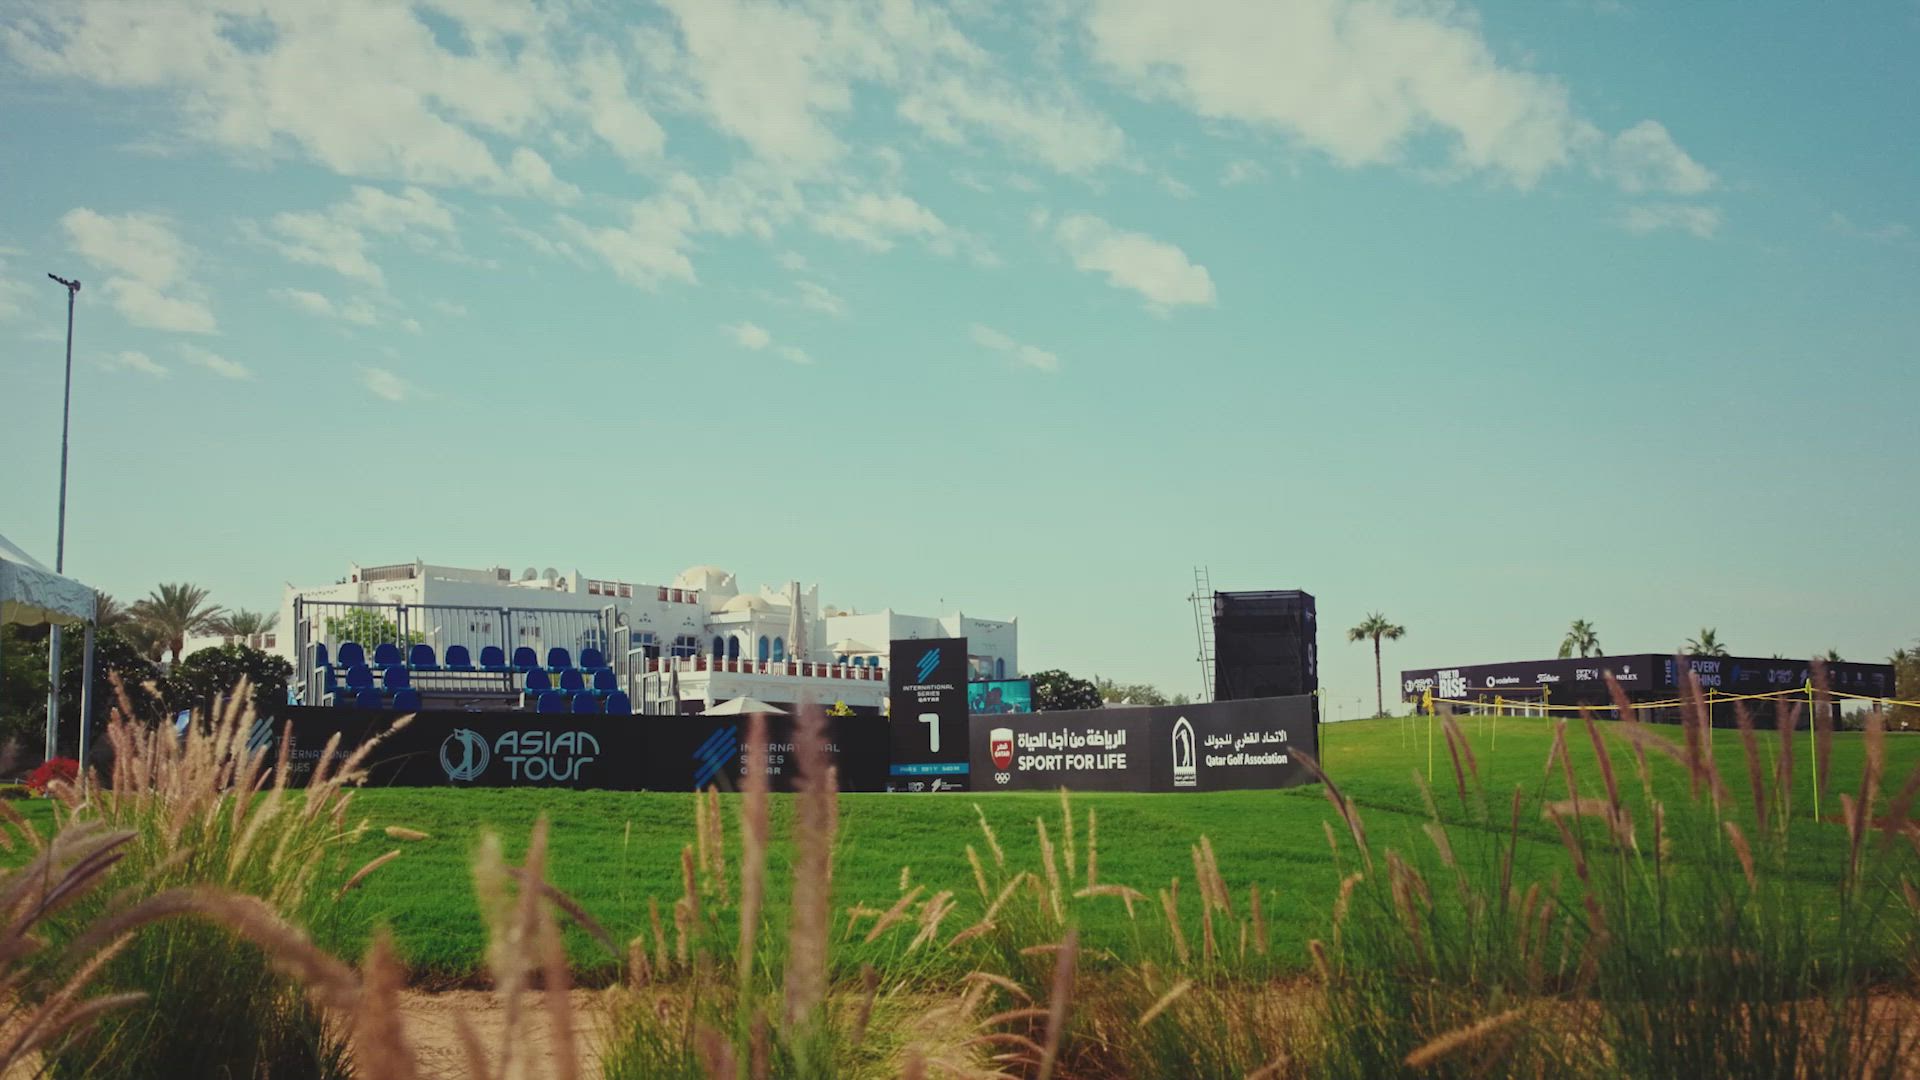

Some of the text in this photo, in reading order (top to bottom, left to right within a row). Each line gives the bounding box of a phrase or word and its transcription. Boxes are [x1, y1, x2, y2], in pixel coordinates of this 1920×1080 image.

[1691, 660, 1720, 673] EVERY
[1616, 673, 1638, 681] ROLEX
[1439, 677, 1467, 698] RISE
[275, 736, 297, 746] TE
[918, 713, 940, 753] 1
[1018, 732, 1047, 751] الحياة
[1069, 731, 1085, 749] من
[1087, 729, 1126, 750] الرياضة
[494, 730, 600, 755] ASIAN
[740, 743, 840, 752] INRNANAL
[274, 763, 310, 772] SIES
[740, 755, 784, 764] SES
[1018, 753, 1127, 771] SPORT FOR LIFE
[1206, 751, 1288, 768] Qatar Golf Association
[503, 756, 594, 781] TOUR
[740, 767, 781, 775] QAR
